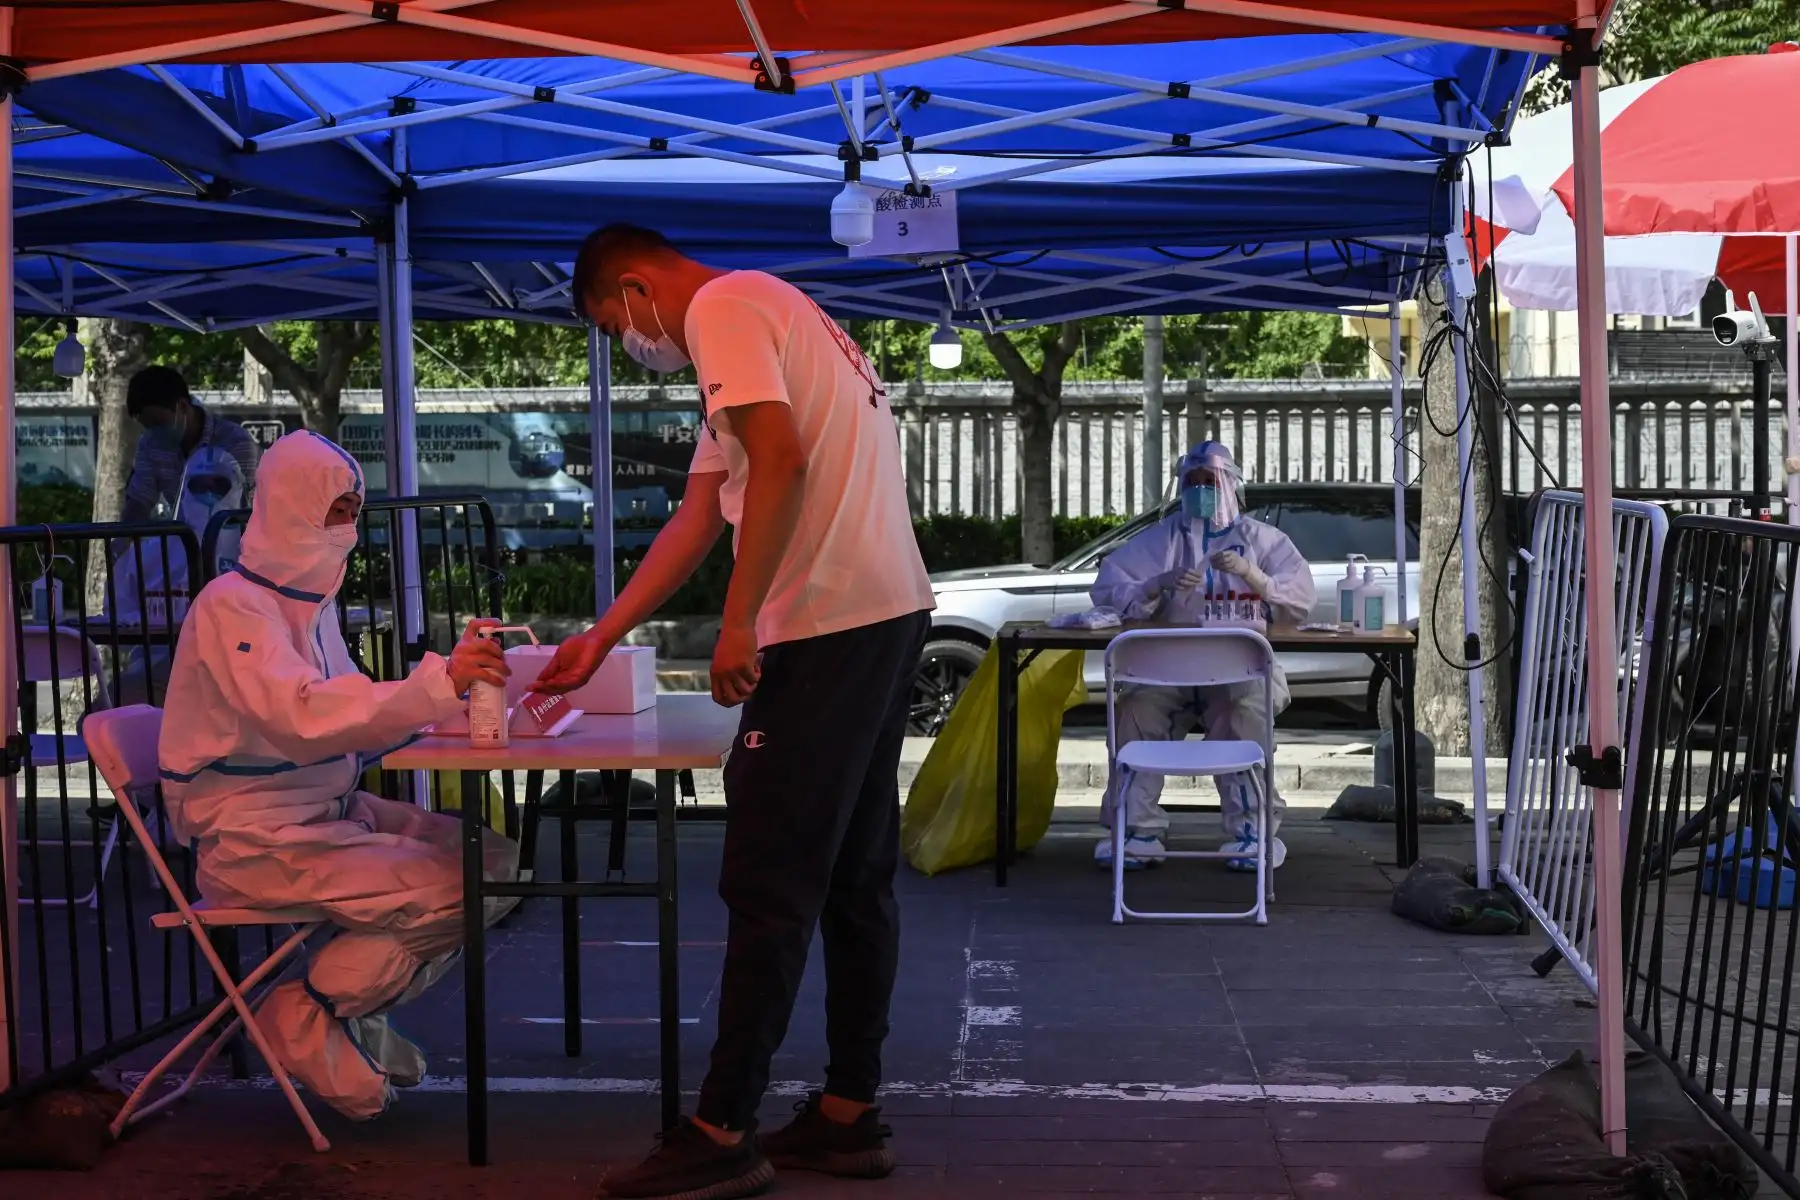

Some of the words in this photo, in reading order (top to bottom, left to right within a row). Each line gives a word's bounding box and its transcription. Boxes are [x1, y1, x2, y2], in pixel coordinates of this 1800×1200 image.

[874, 194, 942, 212] 酸检测点
[897, 221, 909, 237] 3
[246, 425, 278, 444] 文明
